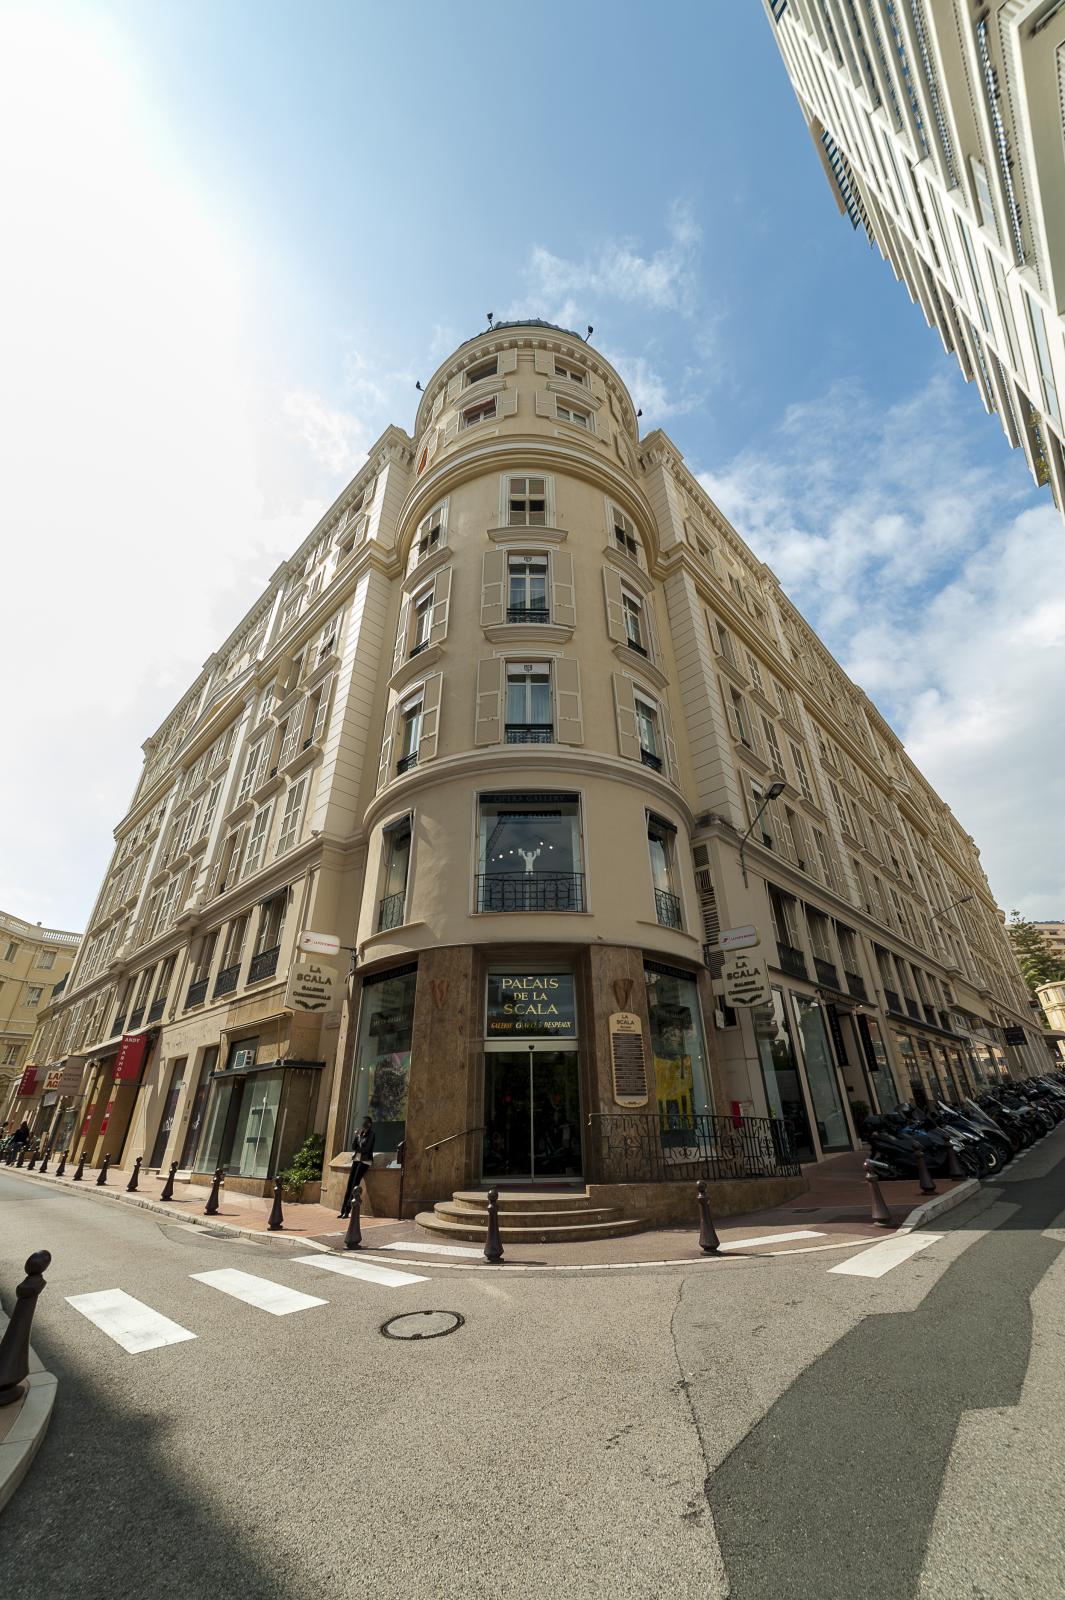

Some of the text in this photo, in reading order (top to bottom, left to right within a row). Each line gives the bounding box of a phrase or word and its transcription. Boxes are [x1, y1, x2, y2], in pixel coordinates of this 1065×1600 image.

[310, 965, 321, 974] LA
[726, 968, 760, 980] SCALA
[296, 973, 332, 986] SCALA
[502, 978, 559, 989] PALAIS
[514, 992, 548, 1000] DE LA
[504, 1004, 558, 1014] SCALA
